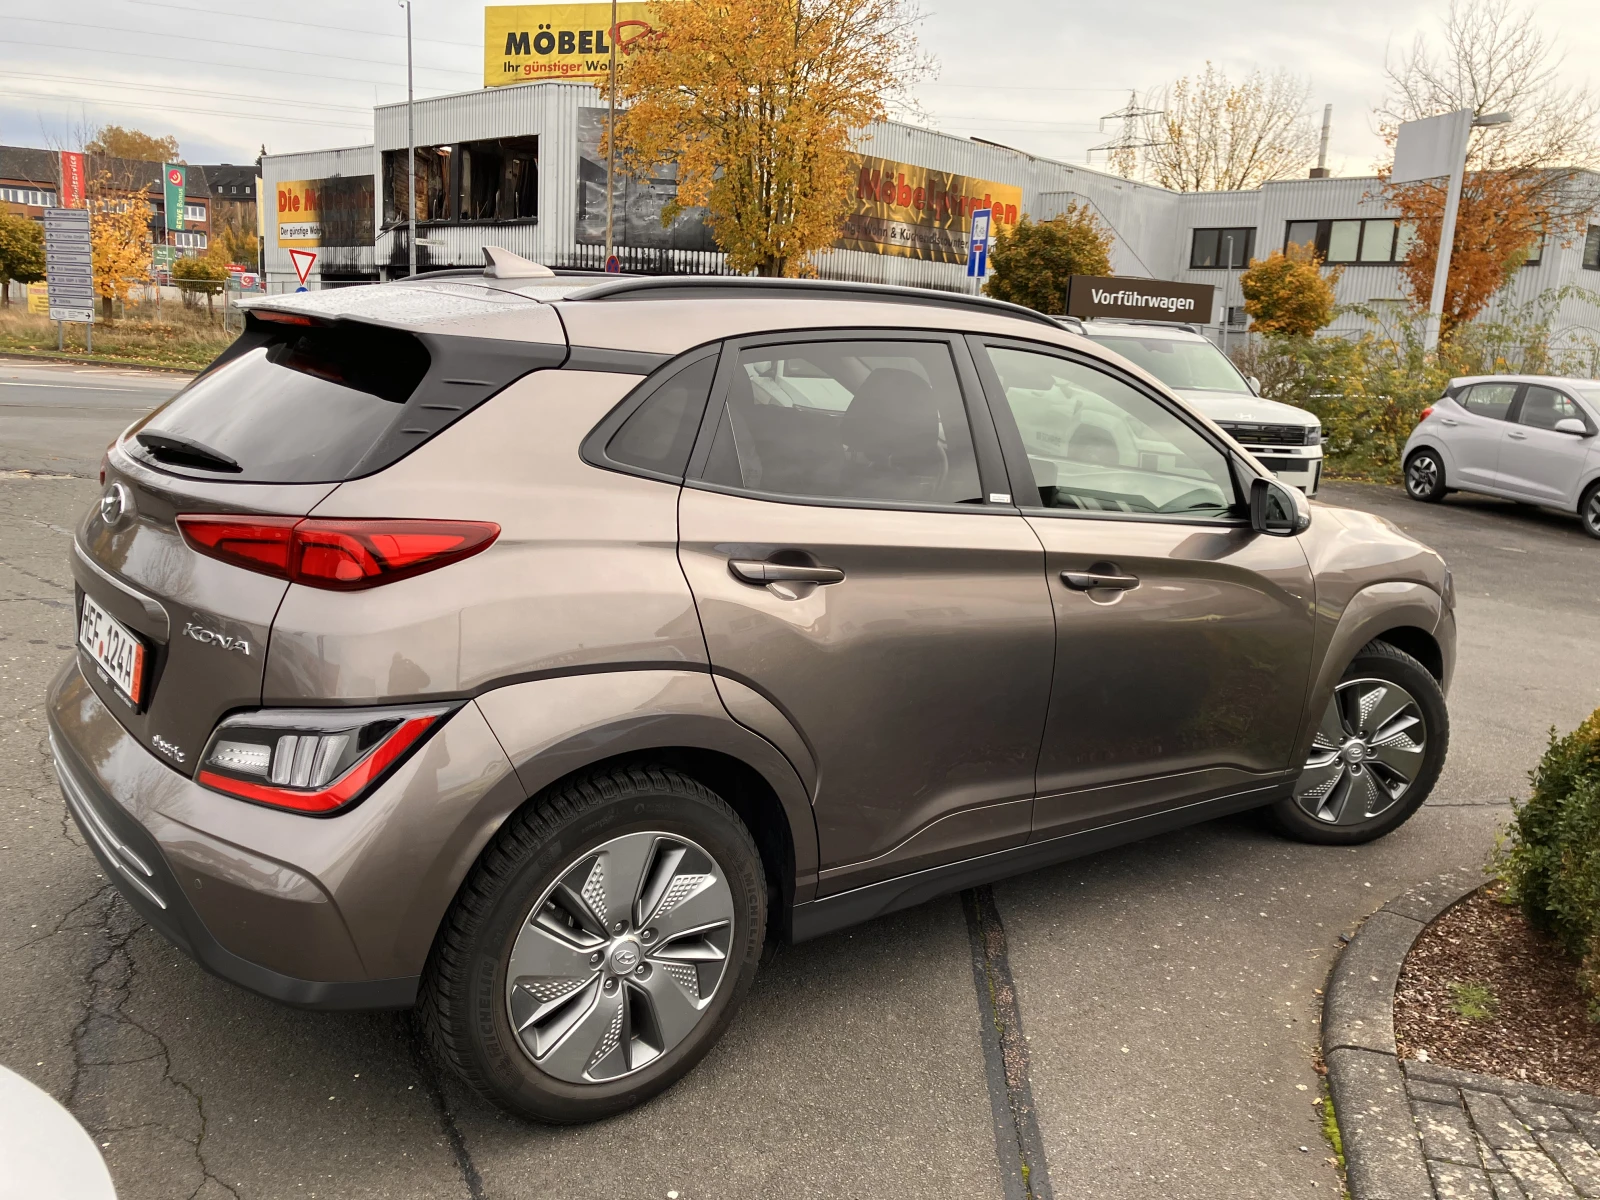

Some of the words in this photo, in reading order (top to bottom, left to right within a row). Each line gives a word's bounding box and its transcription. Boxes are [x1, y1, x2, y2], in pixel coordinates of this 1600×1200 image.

[504, 23, 610, 56] MÖBEL
[503, 61, 521, 73] Ihr
[523, 60, 583, 75] günstiger
[278, 188, 301, 213] Die
[857, 167, 1018, 225] Möbelpiraten
[280, 226, 289, 236] Der
[289, 226, 309, 238] günstige
[864, 223, 889, 238] Wohn
[890, 227, 898, 239] &
[1091, 288, 1195, 312] Vorführwagen
[81, 599, 103, 650] HEF
[103, 623, 133, 689] 124A
[182, 622, 250, 656] KONA
[743, 871, 760, 958] MICHELIN
[479, 959, 502, 1060] MICHELIN
